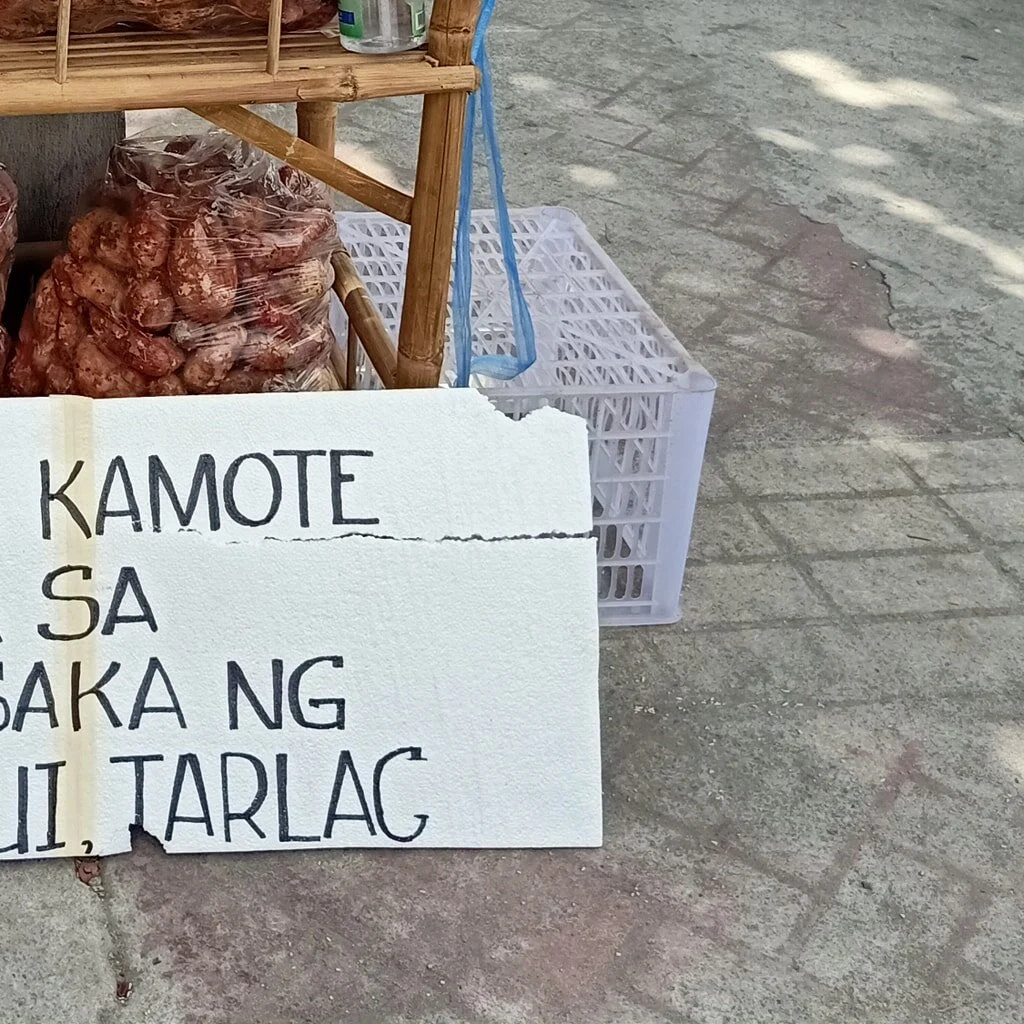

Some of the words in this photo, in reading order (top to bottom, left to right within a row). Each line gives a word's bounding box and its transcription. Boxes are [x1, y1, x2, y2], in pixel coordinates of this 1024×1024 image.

[39, 449, 380, 540] KAMOTE
[37, 564, 158, 642] SA
[226, 655, 346, 731] NG
[110, 746, 430, 844] TARLAC
